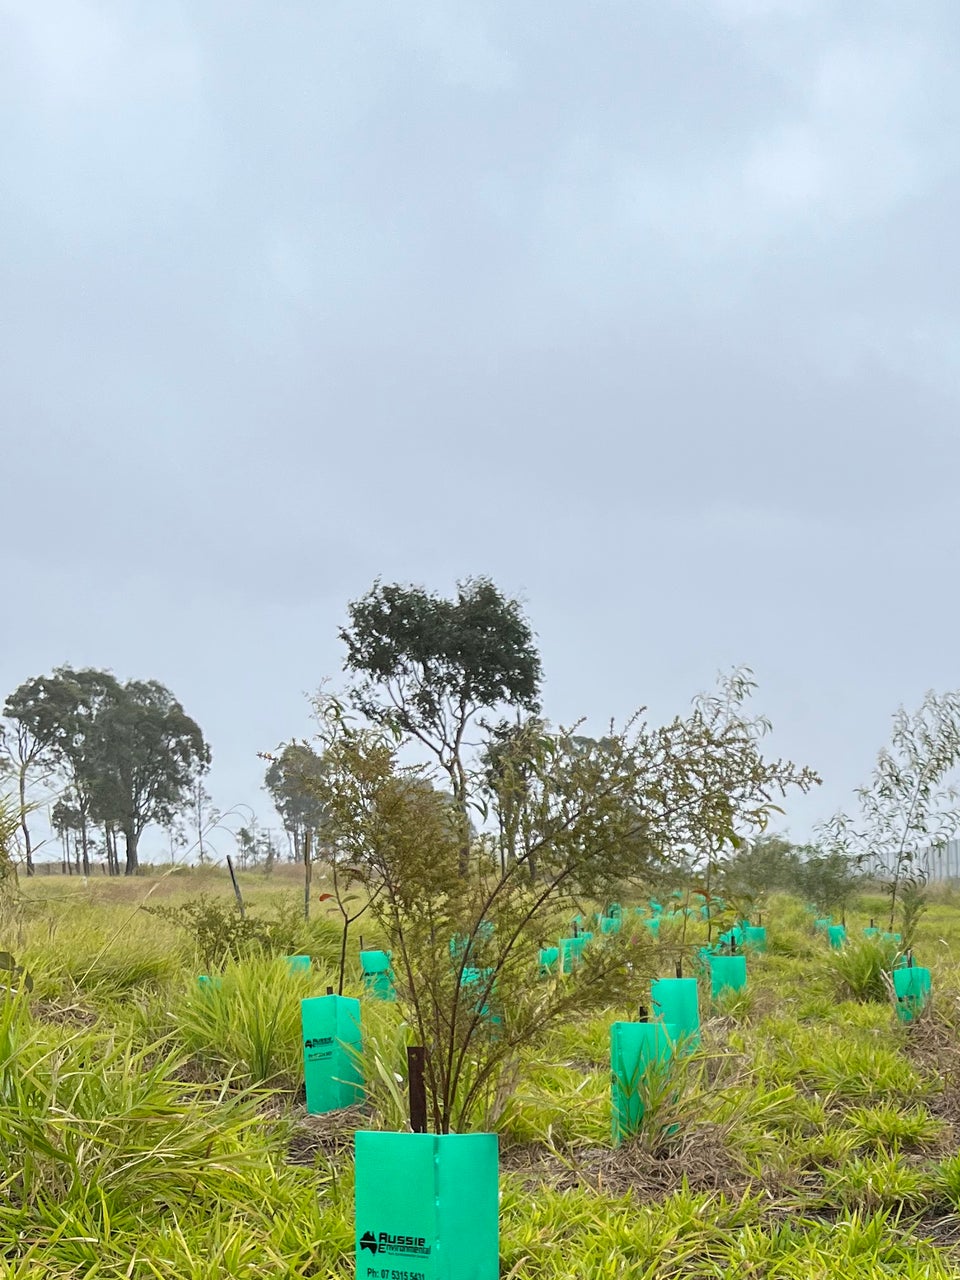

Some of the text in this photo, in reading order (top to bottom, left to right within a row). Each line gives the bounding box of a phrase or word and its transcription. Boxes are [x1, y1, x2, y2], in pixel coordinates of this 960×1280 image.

[378, 1232, 426, 1247] Aussie
[378, 1243, 432, 1255] Environmental
[367, 1267, 379, 1278] Ph:
[381, 1269, 389, 1279] 07
[391, 1270, 408, 1280] 5315
